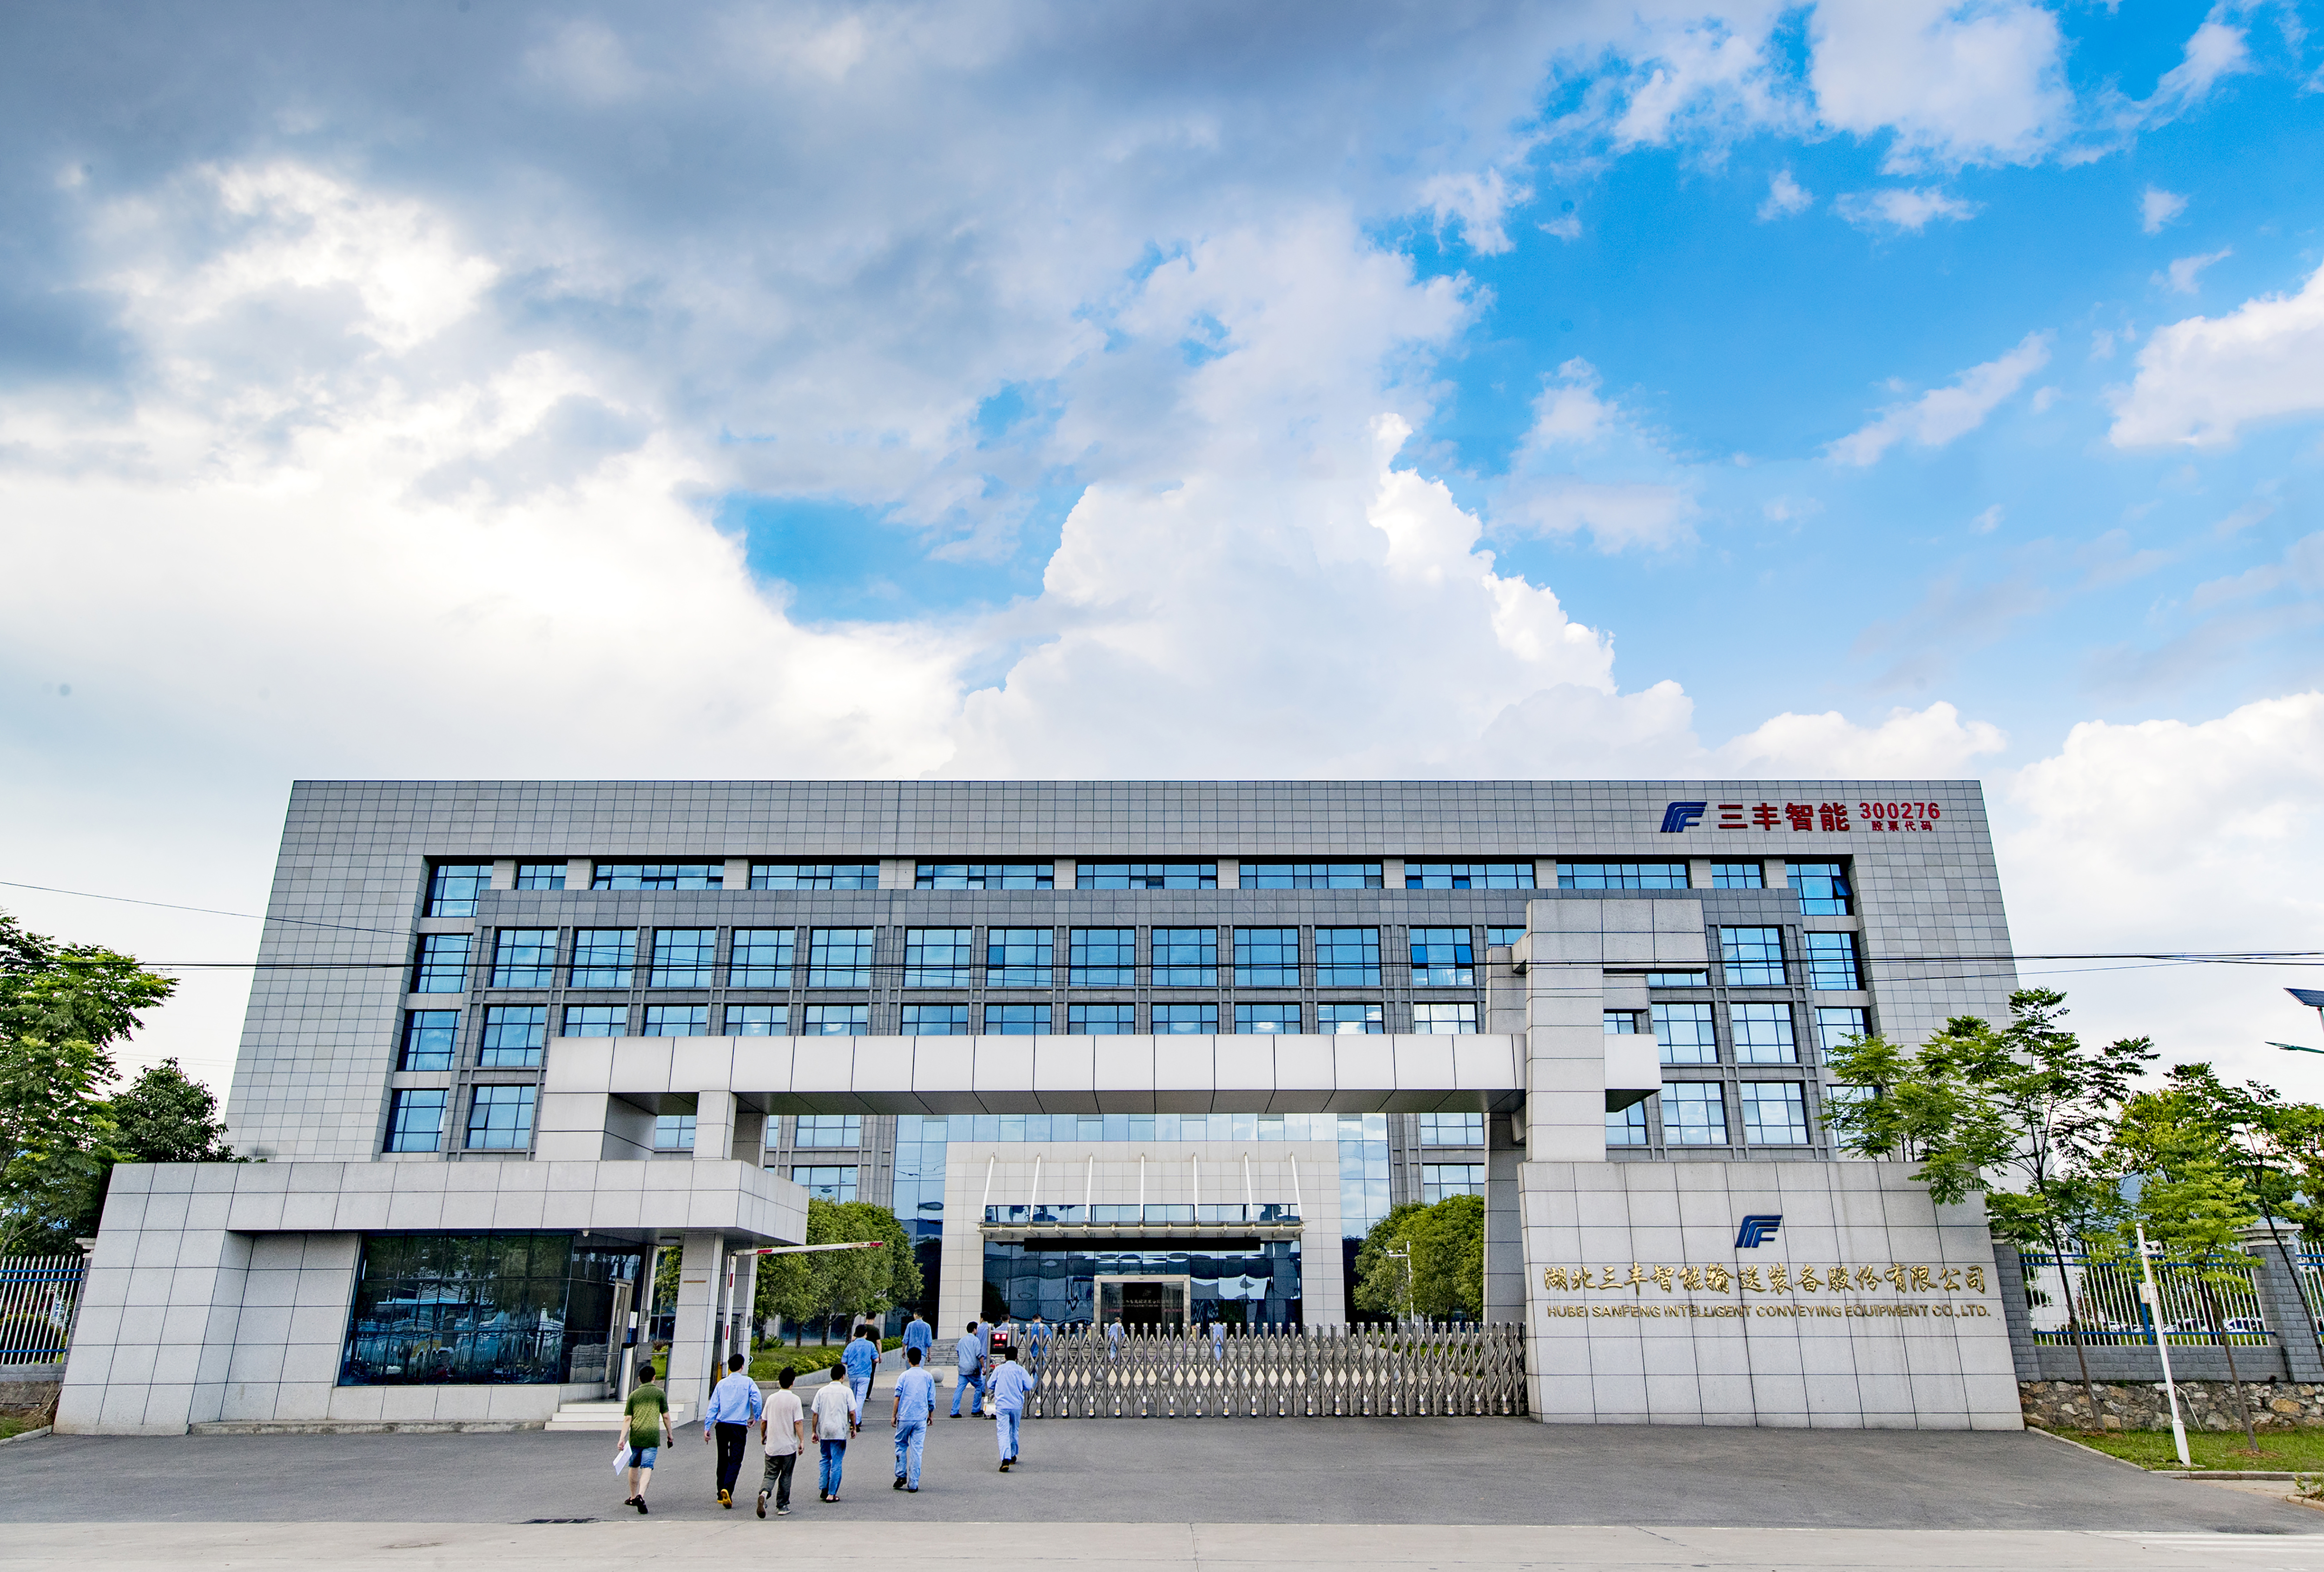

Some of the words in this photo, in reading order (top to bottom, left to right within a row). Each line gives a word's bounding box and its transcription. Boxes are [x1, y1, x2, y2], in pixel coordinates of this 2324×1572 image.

[1718, 802, 1850, 832] 三丰智能
[1859, 802, 1941, 820] 300276
[1871, 821, 1933, 832] 股票代码
[1544, 1261, 1985, 1296] 湖北三丰智能输送装备股份有限公司
[1547, 1305, 1589, 1317] HUBEI
[1592, 1305, 1661, 1317] SANFENG
[1664, 1305, 1752, 1317] INTELLIGENT
[1756, 1304, 1842, 1317] CONVEYING
[1845, 1304, 1928, 1317] EQUIPMENT
